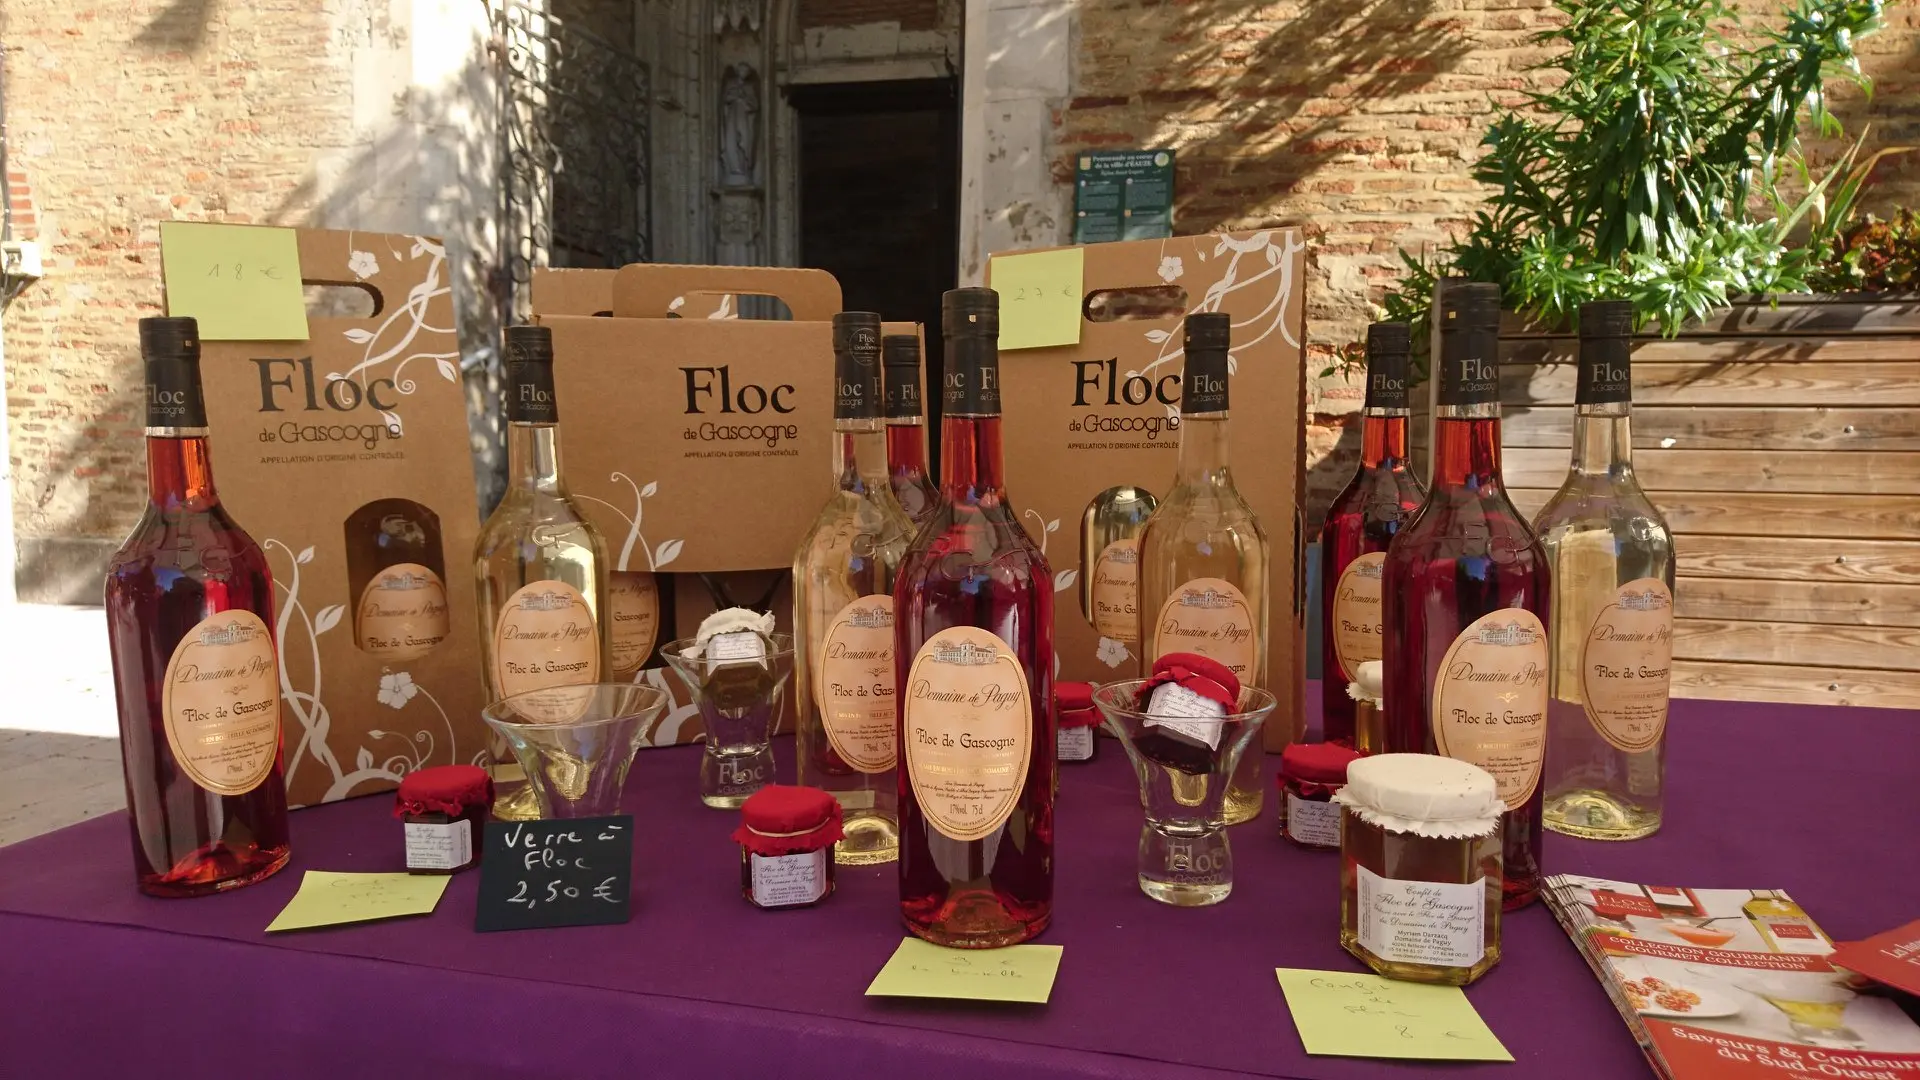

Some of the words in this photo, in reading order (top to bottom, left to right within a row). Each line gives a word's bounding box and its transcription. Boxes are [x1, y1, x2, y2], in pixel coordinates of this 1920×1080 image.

[249, 356, 398, 413] Floc
[678, 365, 797, 414] Floc
[838, 376, 862, 397] loc
[1071, 357, 1181, 406] Floc
[1193, 374, 1225, 394] Floc
[1372, 374, 1404, 391] Floc
[259, 429, 276, 443] de
[279, 421, 403, 450] Gascogne
[684, 428, 698, 440] de
[699, 422, 798, 448] Gascogne
[1069, 420, 1081, 432] de
[1083, 413, 1180, 440] Gascogne
[684, 450, 727, 459] APPELLATION
[1067, 442, 1108, 450] APPELLATION
[1109, 441, 1141, 449] D'ORIGINE
[1142, 440, 1179, 449] CONTRÔLÉE
[260, 454, 314, 464] APPELLATION
[614, 611, 650, 622] Gascogne
[1342, 620, 1359, 632] Floc
[1362, 622, 1371, 633] de
[503, 624, 549, 641] Domaine
[551, 631, 561, 640] de
[1161, 618, 1208, 638] Domaine
[1210, 628, 1219, 638] de
[1218, 622, 1250, 644] Paguy
[1593, 624, 1644, 642] Domaine
[391, 637, 401, 647] de
[828, 641, 879, 661] Domaine
[878, 649, 888, 660] de
[176, 664, 235, 684] Domaine
[238, 667, 247, 678] de
[506, 661, 527, 674] Floc
[530, 663, 541, 674] de
[545, 660, 589, 674] Gascogne
[1450, 661, 1511, 682] Domaine
[1511, 673, 1521, 682] de
[1594, 664, 1620, 678] Floc
[1623, 667, 1634, 679] de
[831, 683, 853, 697] Floc
[857, 685, 868, 697] de
[872, 683, 896, 697] Gasc
[913, 678, 966, 704] Domaine
[968, 692, 980, 706] de
[980, 683, 1022, 711] Paguy
[182, 708, 210, 723] Floc
[215, 705, 227, 719] de
[232, 698, 273, 716] Gascogne
[1452, 708, 1480, 725] Floc
[1485, 712, 1498, 725] de
[1502, 709, 1543, 726] Gascogne
[916, 727, 938, 746] Floc
[942, 729, 955, 748] de
[960, 732, 1016, 751] Gascogne
[717, 756, 765, 786] Floc
[504, 823, 583, 849] Verre
[524, 847, 592, 871] Floc
[1166, 843, 1224, 873] Floc
[506, 880, 580, 910] 2,50
[592, 876, 622, 904] €
[1405, 886, 1431, 898] Confit
[1433, 888, 1442, 897] de
[1598, 895, 1651, 909] FLOC
[1377, 893, 1402, 906] Floc
[1405, 897, 1417, 908] de
[1421, 897, 1474, 914] Gascogne
[1389, 916, 1427, 929] Domaine
[1428, 921, 1437, 929] de
[1441, 921, 1469, 934] Paguy
[1422, 931, 1448, 940] Darzacq
[1394, 935, 1422, 943] Domaine
[1432, 938, 1452, 947] Paguy
[1609, 936, 1704, 956] COLLECTION
[1708, 950, 1814, 963] GOURMANDE
[1624, 944, 1701, 962] GOURMET
[1705, 956, 1806, 970] COLLECTION
[1671, 1026, 1770, 1055] Saveurs
[1778, 1046, 1802, 1060] &
[1807, 1050, 1920, 1072] Couleurs
[1717, 1047, 1750, 1062] du
[1756, 1052, 1900, 1080] Sud-Ouest
